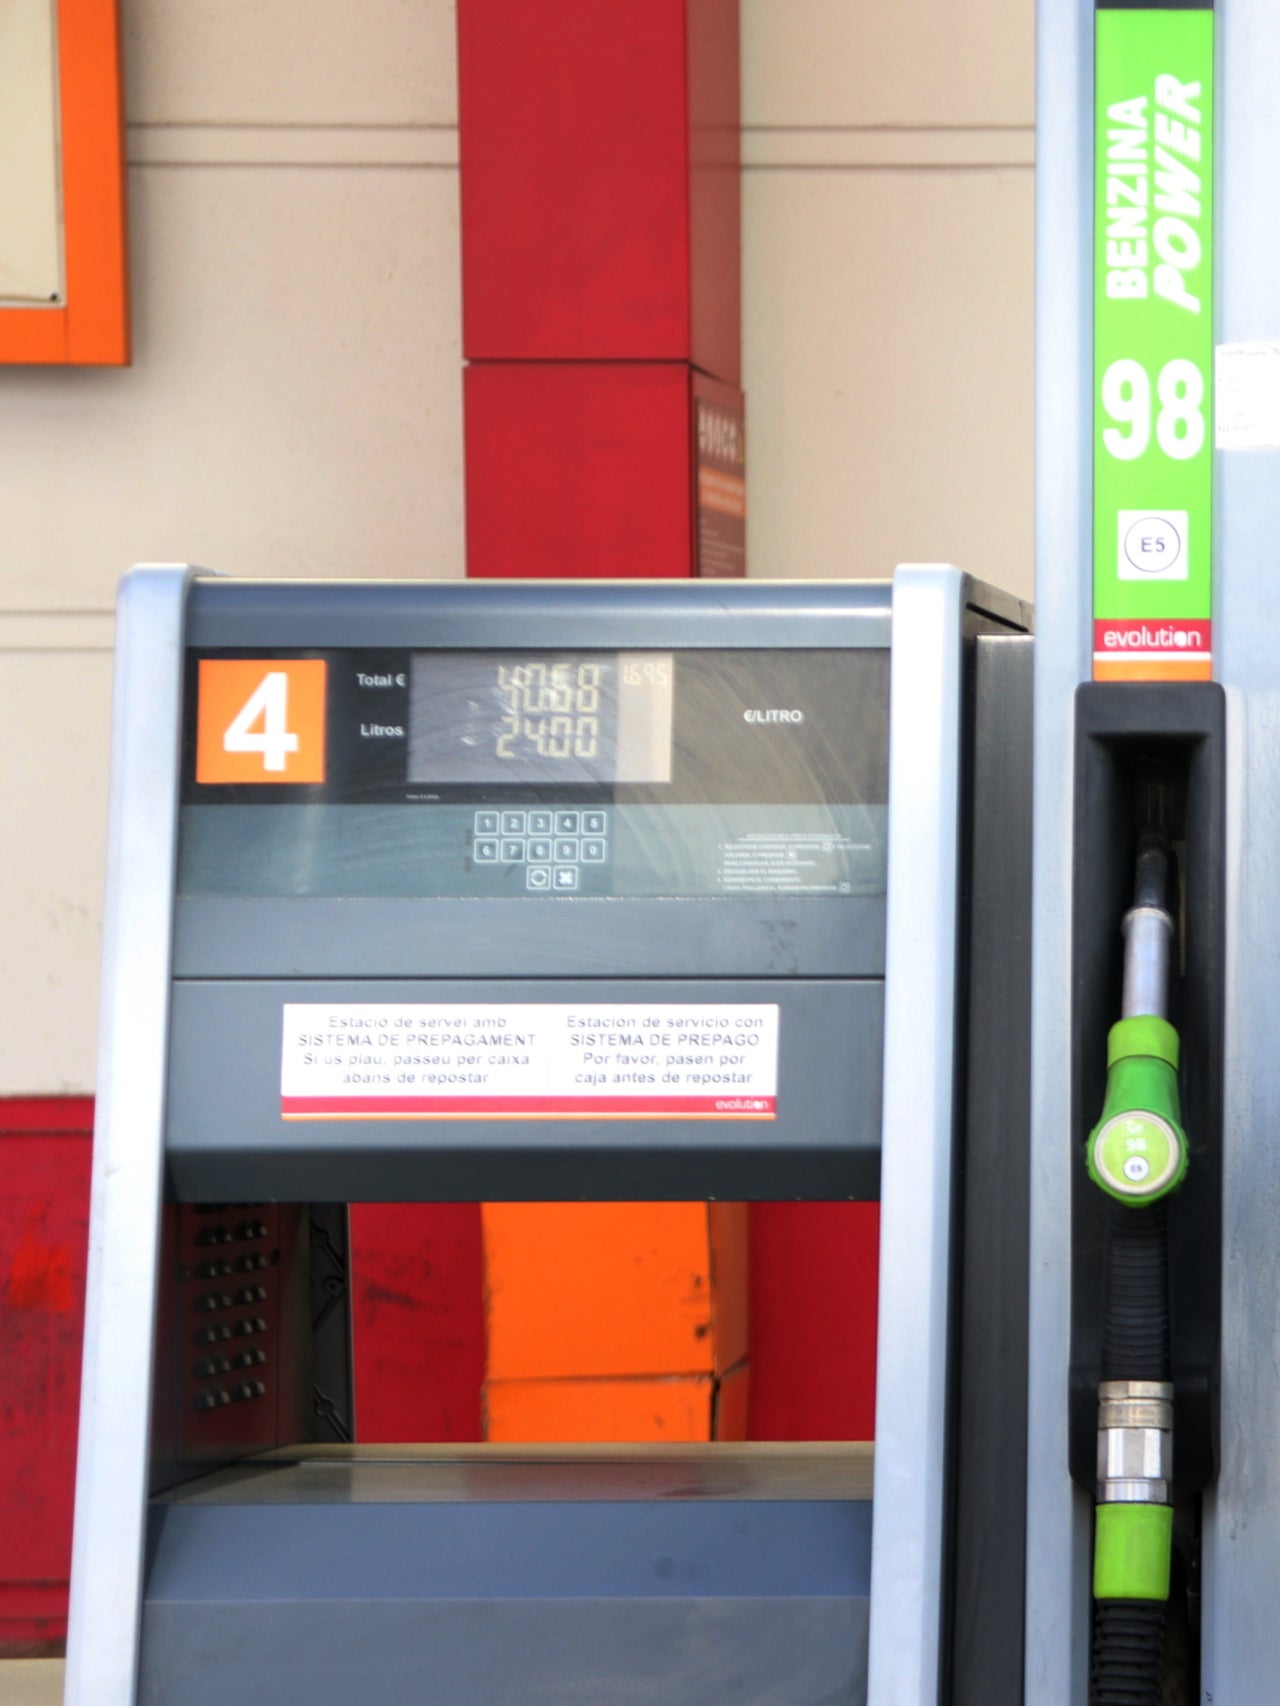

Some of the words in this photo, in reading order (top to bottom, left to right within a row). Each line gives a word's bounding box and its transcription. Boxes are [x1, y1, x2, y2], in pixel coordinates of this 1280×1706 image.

[1106, 96, 1148, 299] BENZINA
[1154, 73, 1201, 314] POWER
[1102, 358, 1205, 460] 98
[1140, 537, 1166, 553] E5
[1103, 626, 1200, 648] evolution
[357, 673, 392, 687] Total
[396, 673, 407, 687] €
[223, 671, 299, 771] 4
[743, 709, 803, 723] €/LITRO
[361, 723, 404, 737] Litros
[484, 818, 491, 829] 1
[511, 818, 518, 829] 2
[537, 818, 545, 829] 3
[563, 818, 571, 829] 4
[590, 818, 598, 829] 5
[482, 845, 490, 856] 6
[509, 845, 518, 856] 7
[562, 845, 570, 856] 9
[589, 845, 597, 856] 0
[394, 1017, 412, 1028] de
[419, 1017, 467, 1028] servei
[473, 1017, 507, 1028] amb
[642, 1017, 660, 1028] de
[667, 1017, 729, 1028] servicio
[735, 1018, 763, 1028] con
[298, 1034, 372, 1047] SISTEMA
[378, 1034, 400, 1047] DE
[406, 1034, 537, 1047] PREPAGAMENT
[570, 1034, 644, 1047] SISTEMA
[650, 1034, 671, 1047] DE
[678, 1034, 759, 1047] PREPAGO
[304, 1052, 318, 1065] Si
[324, 1055, 342, 1065] us
[393, 1055, 451, 1068] passeu
[457, 1055, 482, 1068] per
[488, 1053, 530, 1065] caixa
[583, 1052, 610, 1065] Por
[616, 1052, 660, 1066] favor,
[666, 1055, 714, 1068] pasen
[719, 1055, 746, 1068] por
[342, 1072, 391, 1083] abans
[397, 1072, 416, 1083] de
[421, 1072, 488, 1085] repostar
[575, 1072, 607, 1086] caja
[612, 1073, 656, 1083] antes
[662, 1072, 680, 1083] de
[686, 1073, 752, 1085] repostar
[715, 1098, 769, 1110] evolution
